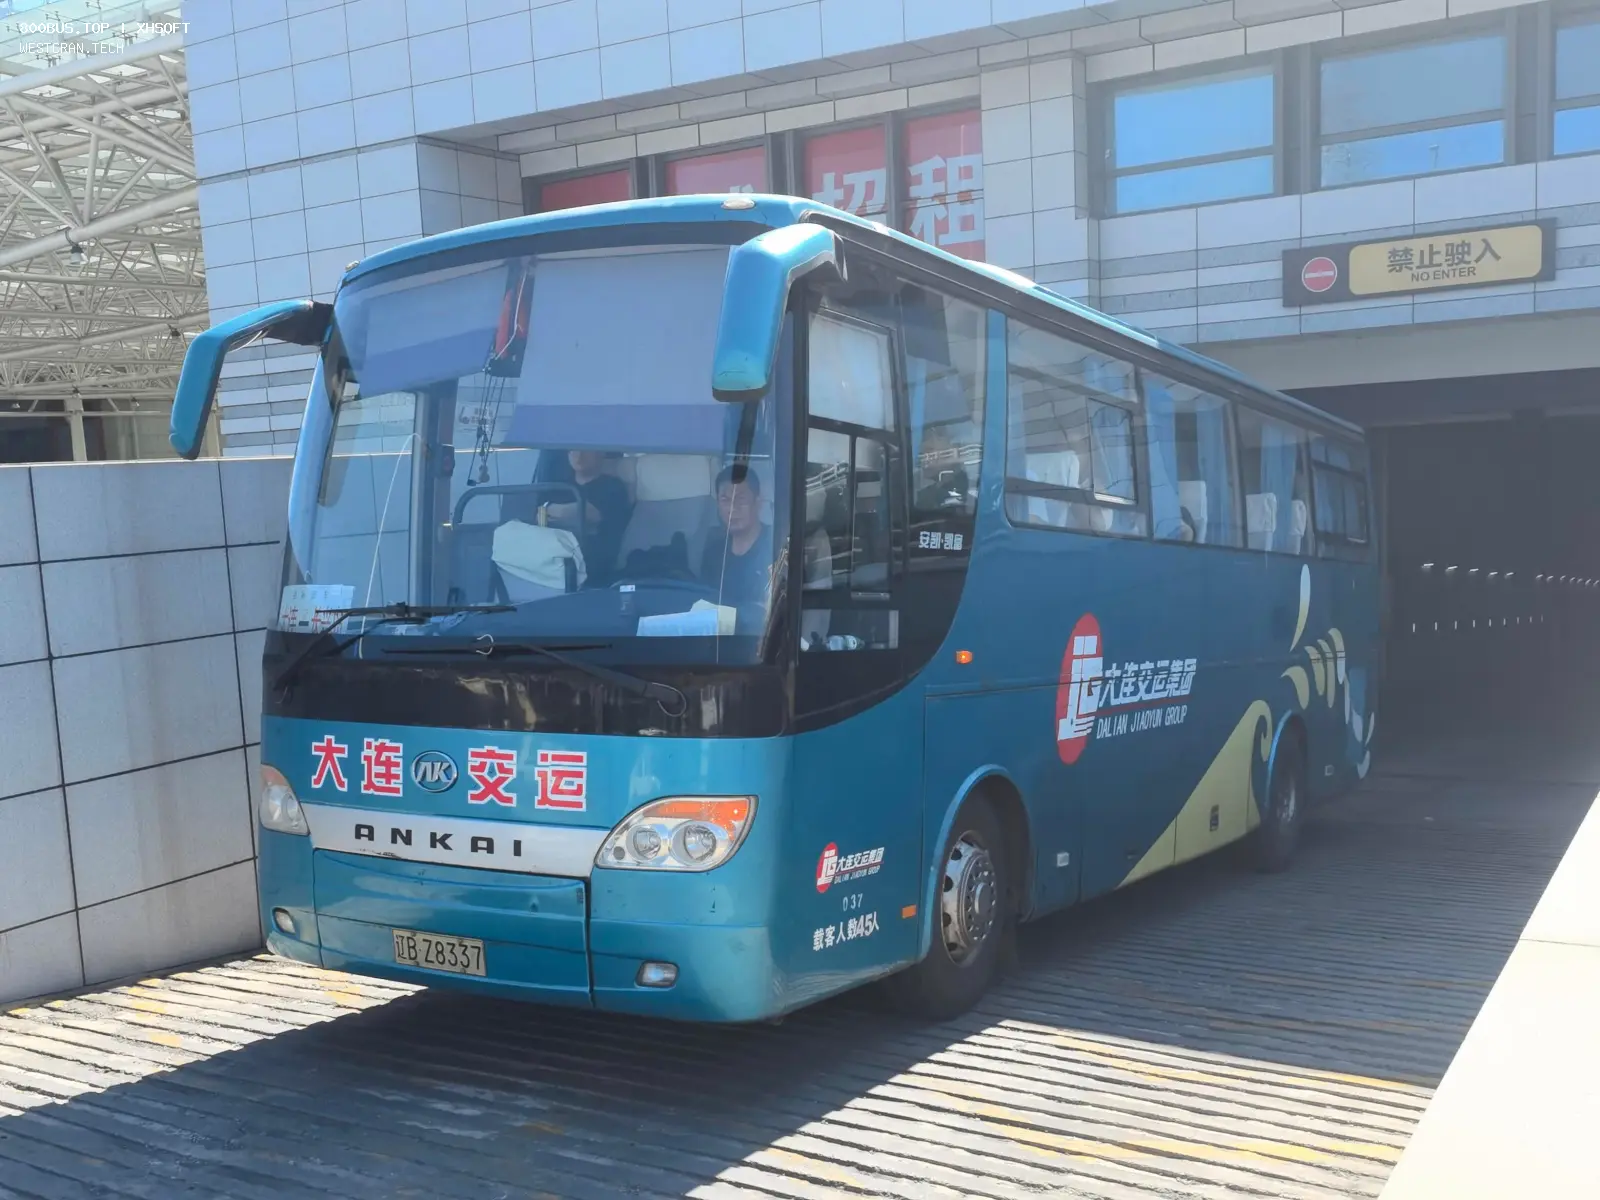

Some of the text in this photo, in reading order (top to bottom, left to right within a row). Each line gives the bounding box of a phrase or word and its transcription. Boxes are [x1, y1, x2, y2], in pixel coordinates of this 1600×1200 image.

[1387, 238, 1502, 274] 禁止驶入
[1411, 266, 1477, 282] NO ENTER
[1098, 658, 1197, 708] 大连交运集团
[1096, 704, 1188, 740] DALIAN JIAOYUN GROUP
[354, 823, 522, 857] ANKAI
